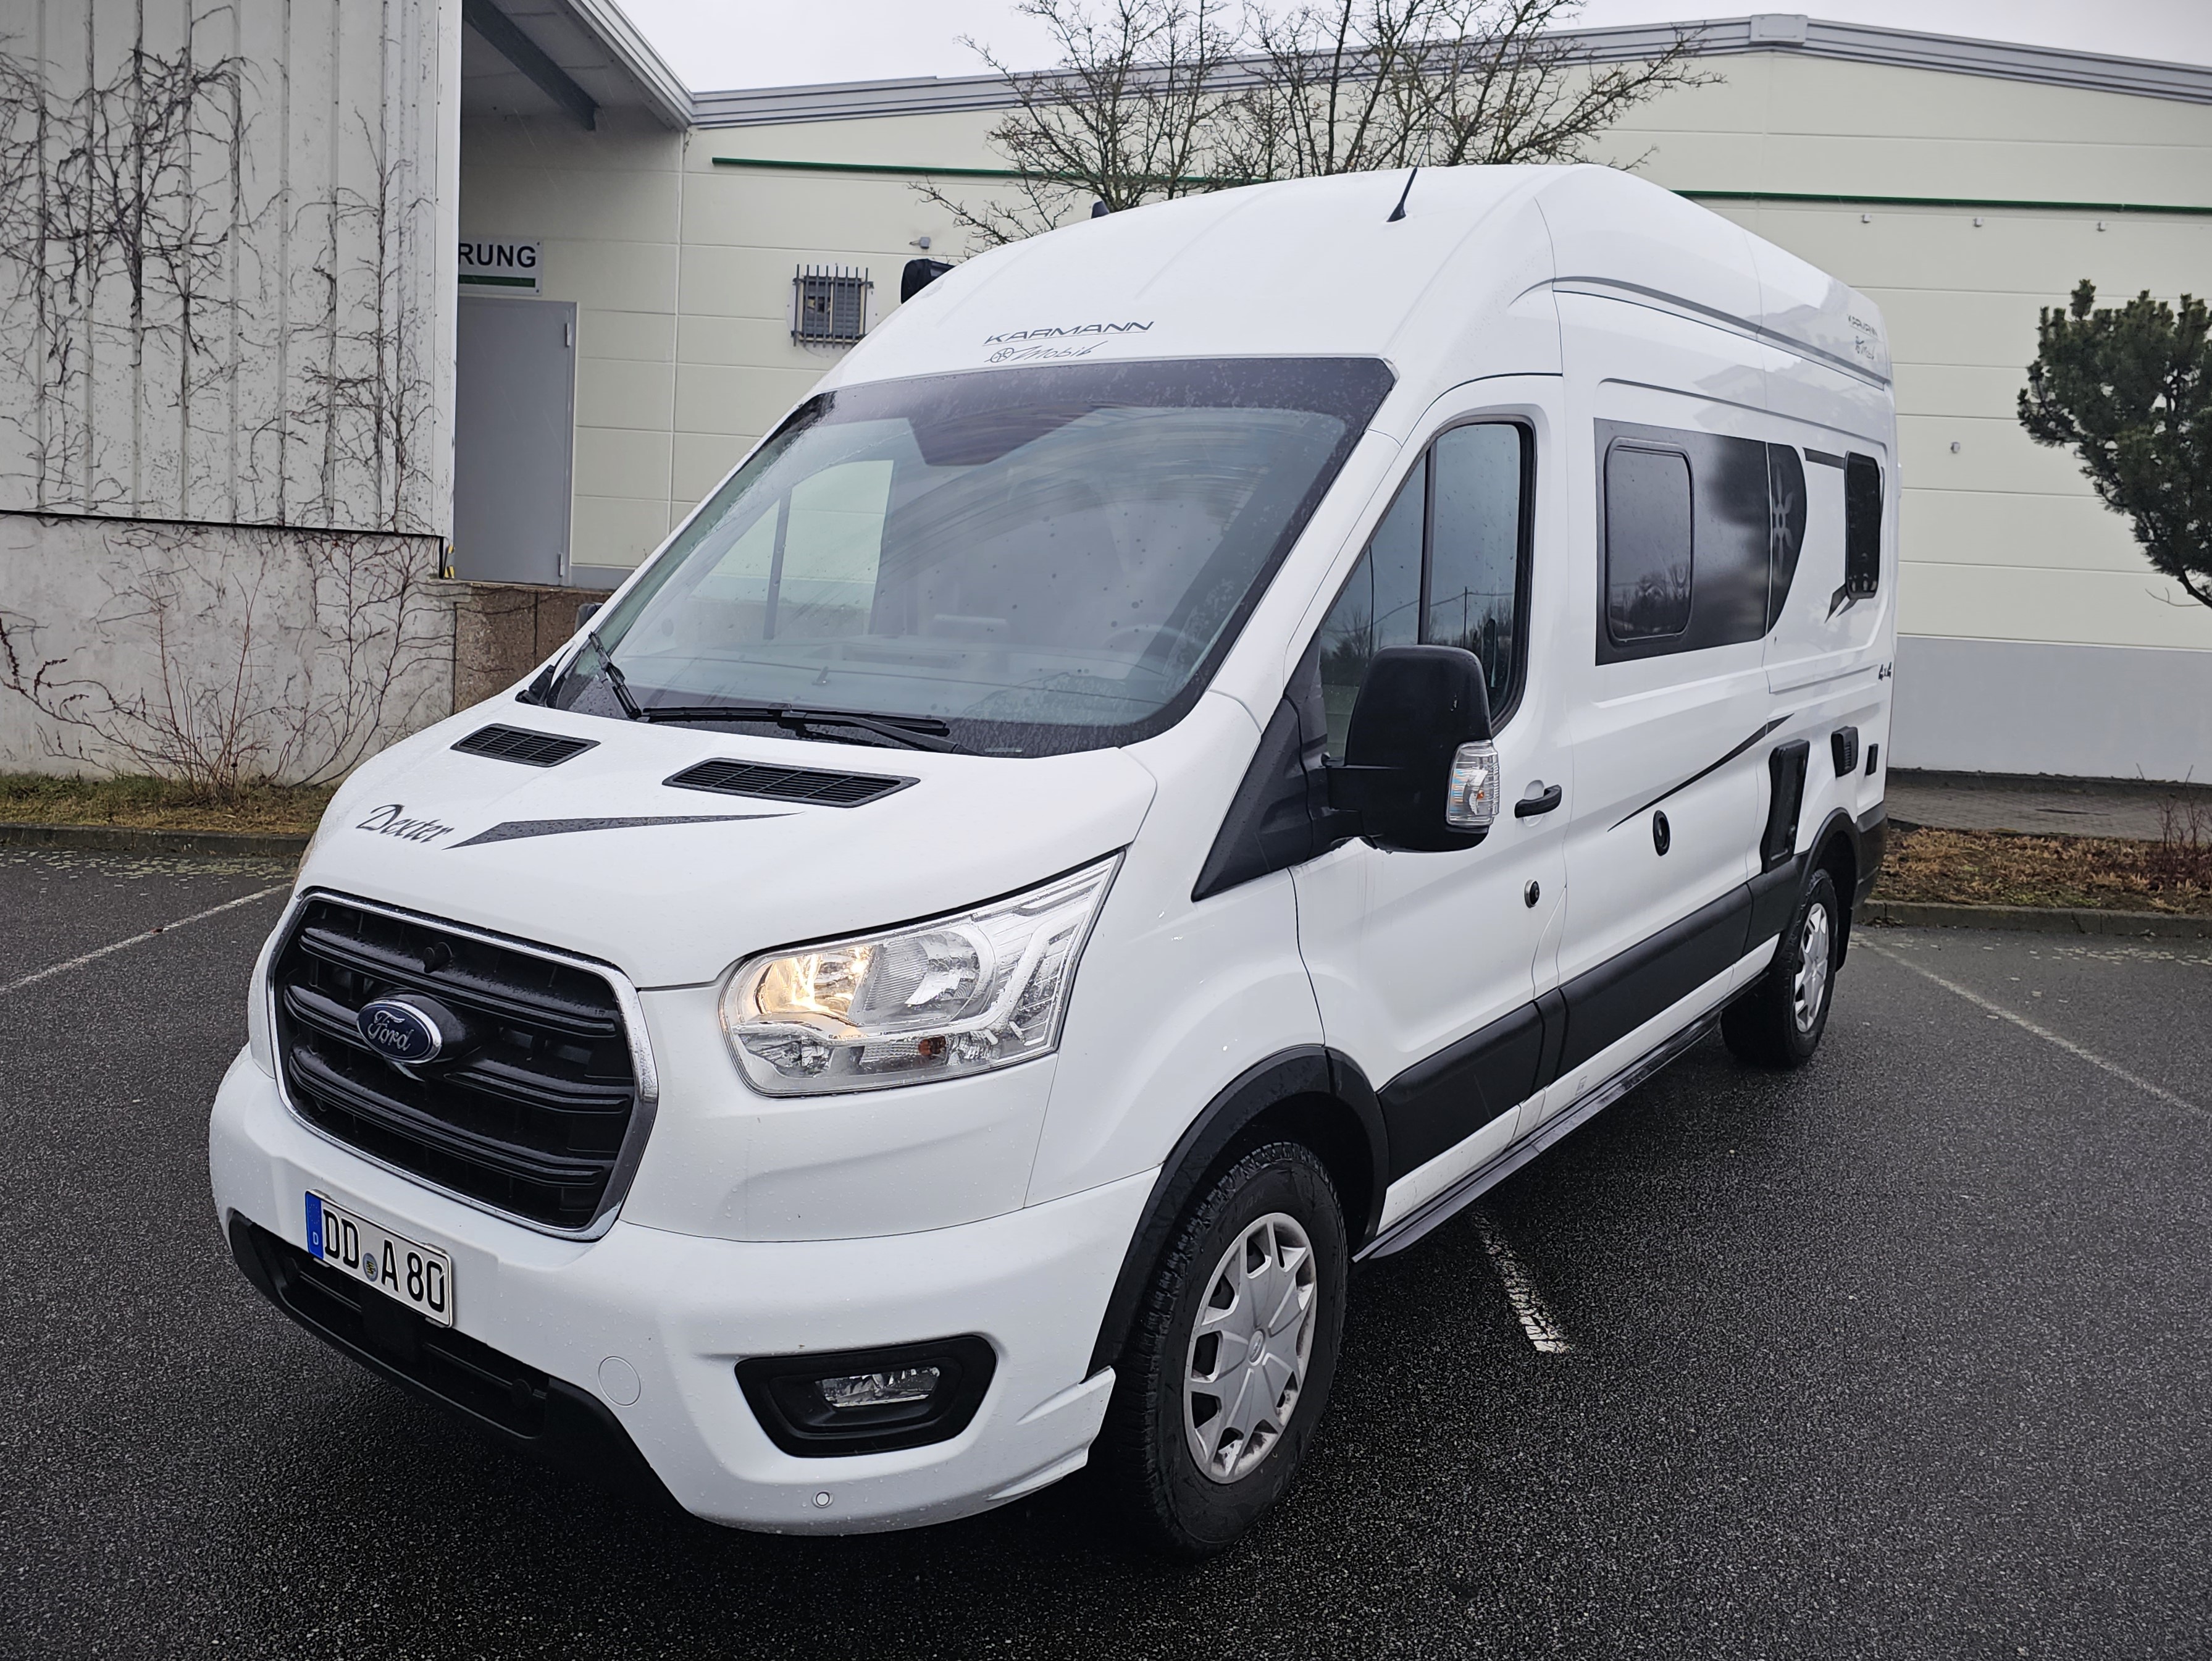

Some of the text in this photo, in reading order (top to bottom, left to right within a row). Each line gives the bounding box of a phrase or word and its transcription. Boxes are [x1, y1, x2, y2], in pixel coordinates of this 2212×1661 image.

[458, 243, 536, 268] RUNG
[984, 321, 1154, 344] KARMANN
[356, 804, 455, 843] Dexter
[367, 1010, 414, 1051] Ford
[312, 1231, 319, 1245] D
[323, 1208, 445, 1313] DD A 80
